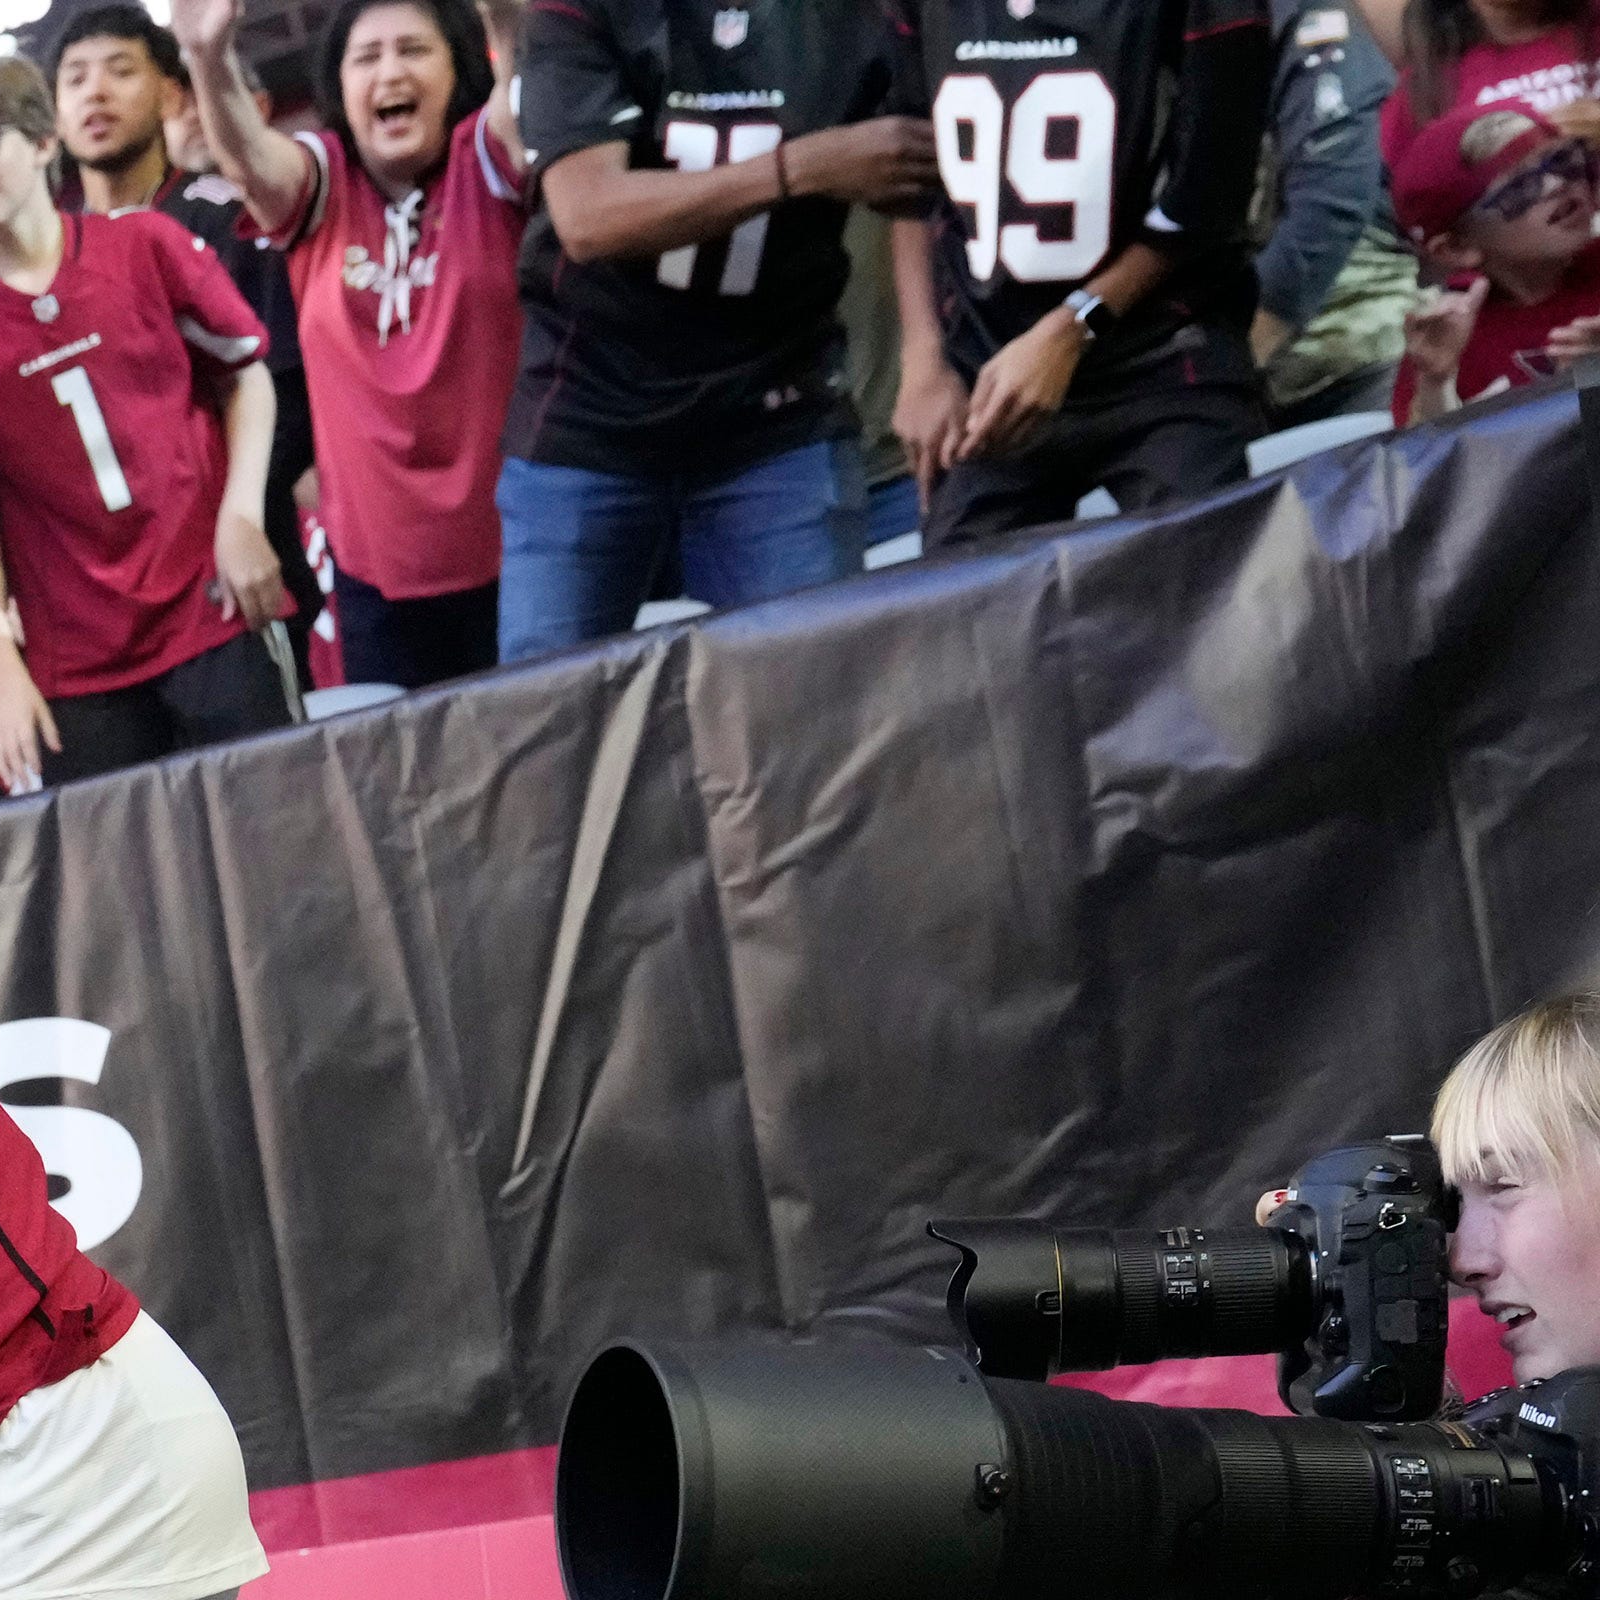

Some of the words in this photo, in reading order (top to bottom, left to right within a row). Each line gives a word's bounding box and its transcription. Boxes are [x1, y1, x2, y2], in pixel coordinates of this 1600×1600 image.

[955, 36, 1078, 61] CARDINALS
[932, 70, 1116, 283] 99
[51, 365, 133, 512] 1
[1518, 1402, 1556, 1428] Nikon
